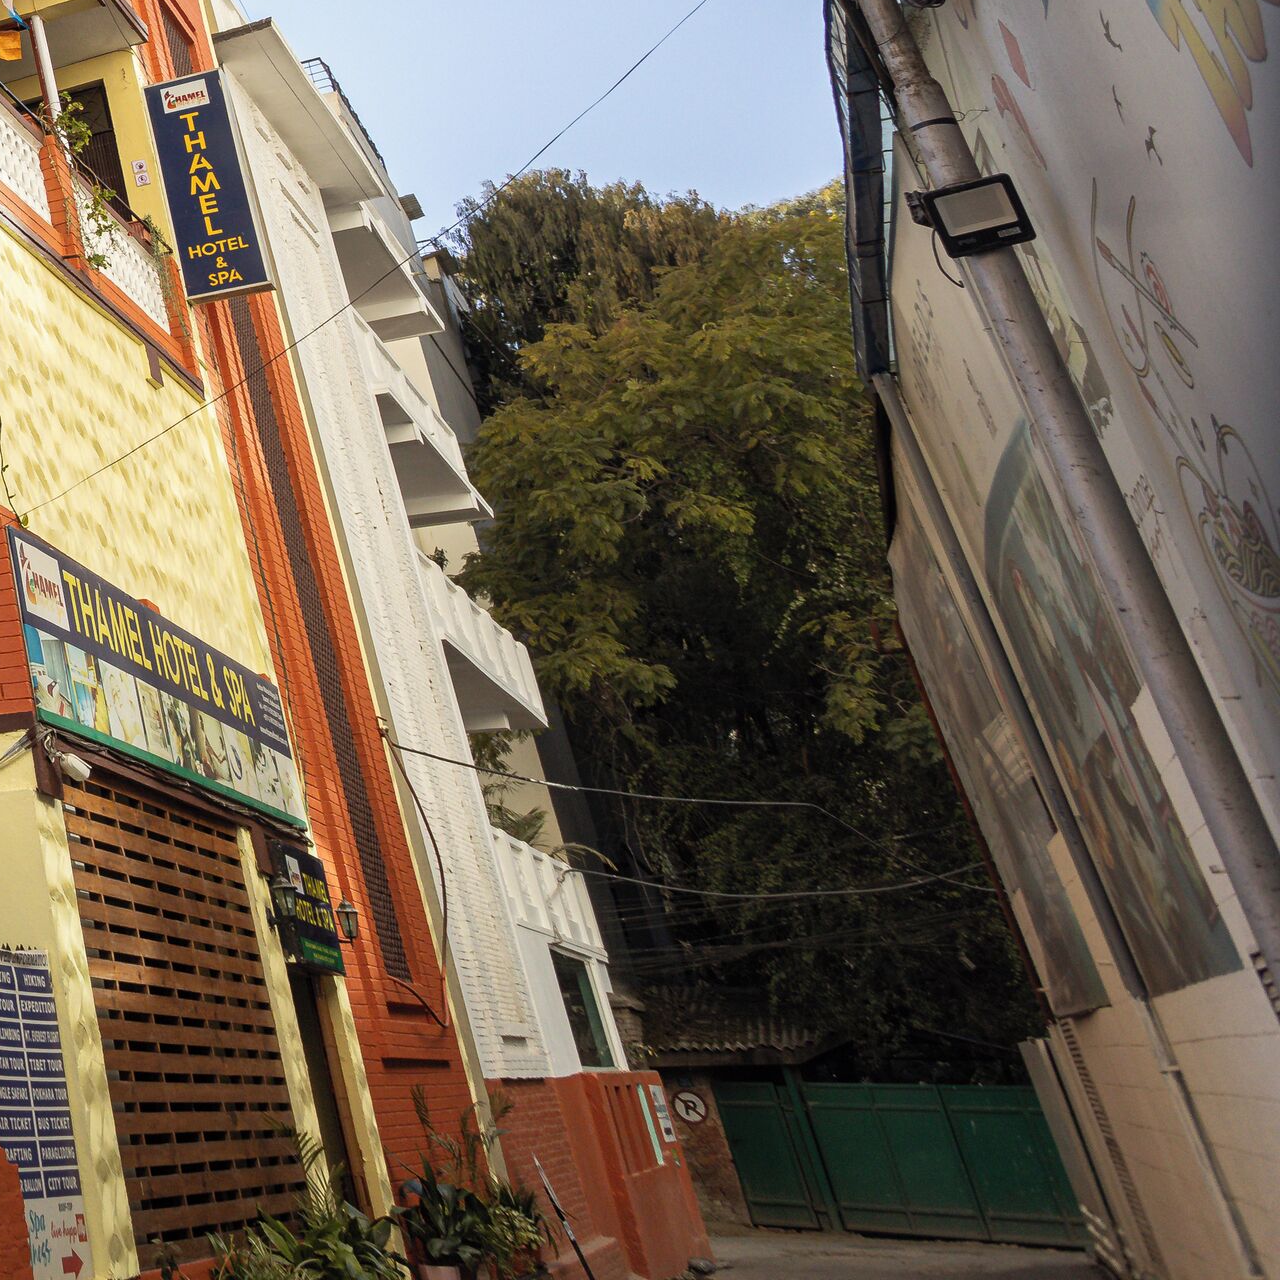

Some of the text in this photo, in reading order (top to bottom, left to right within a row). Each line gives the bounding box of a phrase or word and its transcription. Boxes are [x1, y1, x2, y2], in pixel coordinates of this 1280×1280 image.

[179, 111, 224, 237] THAMEL
[188, 235, 249, 259] HOTEL
[215, 256, 228, 269] &
[208, 268, 243, 287] SPA
[62, 569, 257, 728] THAMEL HOTEL & SPA
[302, 872, 329, 904] THAMEL
[23, 973, 46, 987] HIKING
[20, 999, 56, 1014] EXPEDITION
[9, 1057, 26, 1071] TOUR
[29, 1058, 64, 1072] TIBET TOUR
[11, 1086, 29, 1100] SAFARI
[32, 1087, 69, 1101] POKHARA TOUR
[9, 1116, 32, 1130] TICKET
[37, 1116, 71, 1130] BUS TICKET
[5, 1147, 33, 1161] RAFTING
[41, 1146, 75, 1160] PARAGLIDING
[47, 1175, 78, 1191] CITY TOUR
[29, 1209, 46, 1240] Spa
